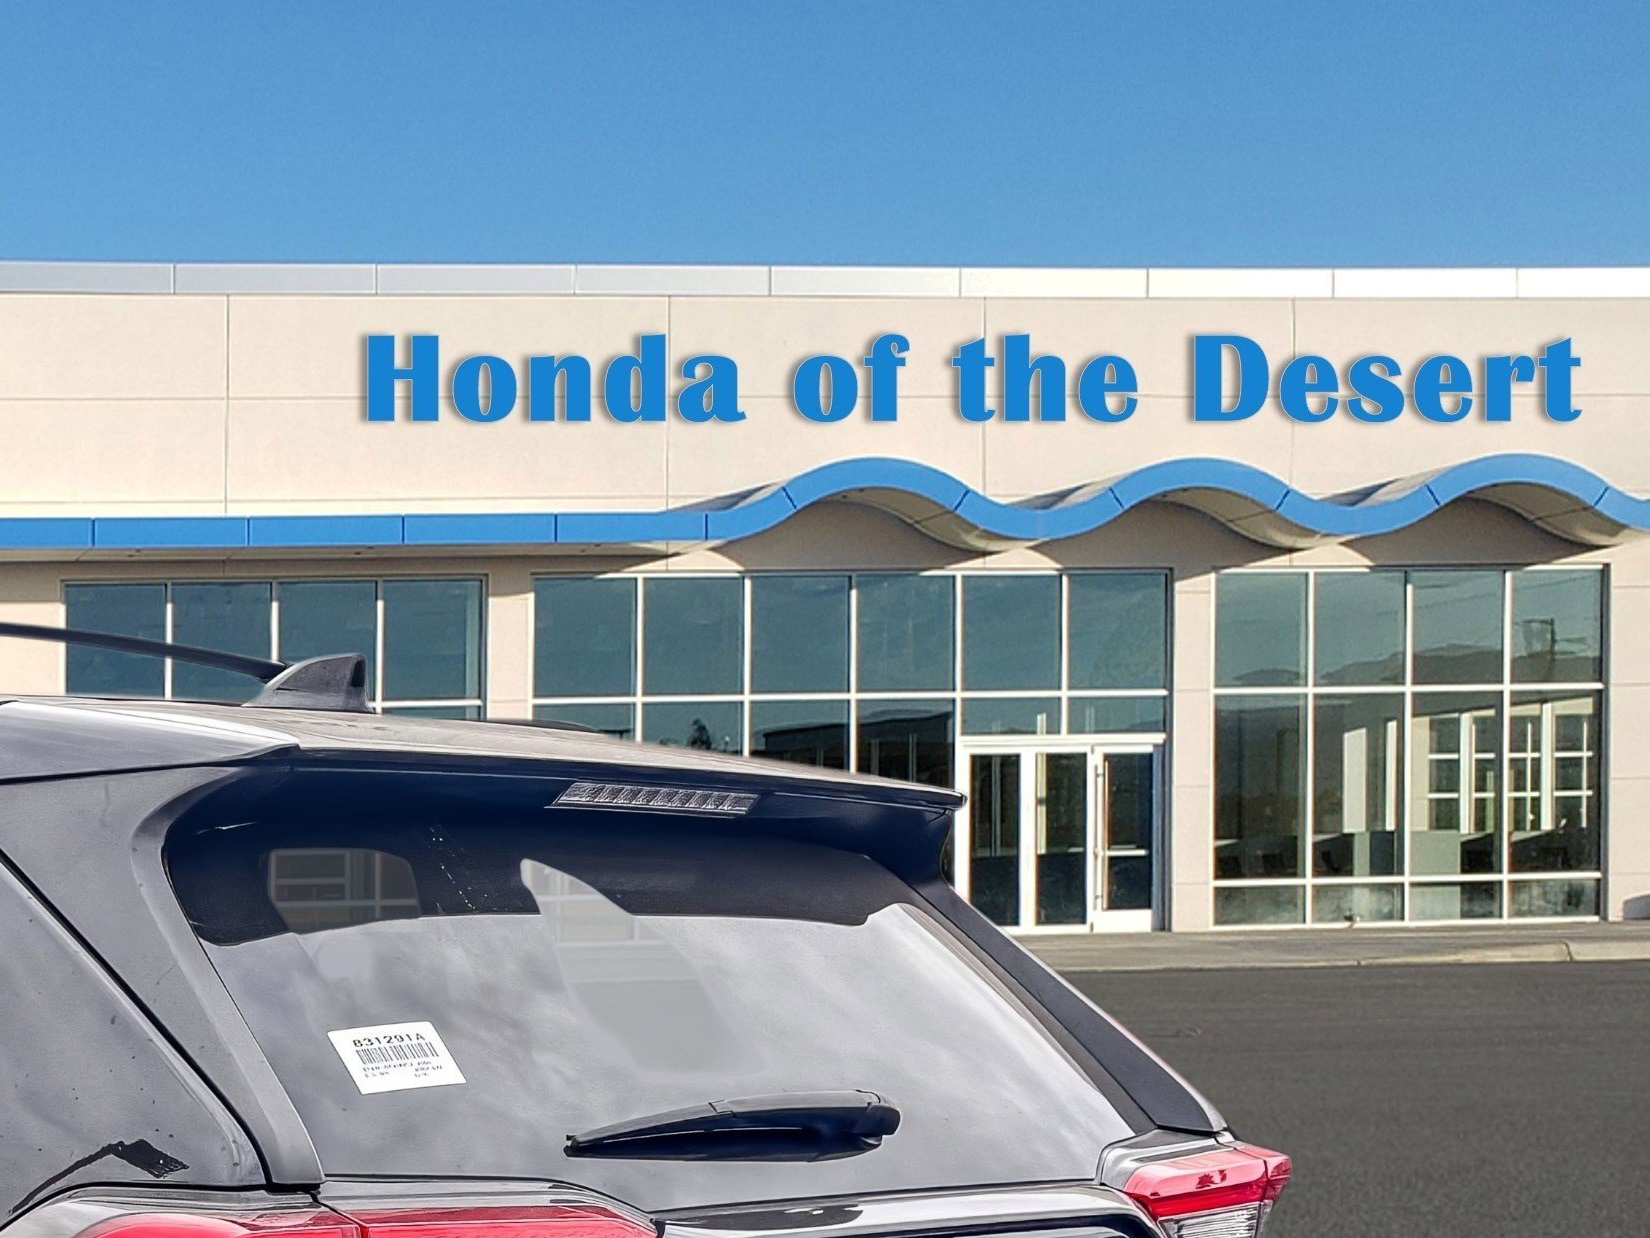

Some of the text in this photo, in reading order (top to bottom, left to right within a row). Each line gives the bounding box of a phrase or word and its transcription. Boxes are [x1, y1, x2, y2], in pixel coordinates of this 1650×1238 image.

[367, 334, 1582, 423] Honda of the Desert
[352, 1032, 426, 1048] 831291A
